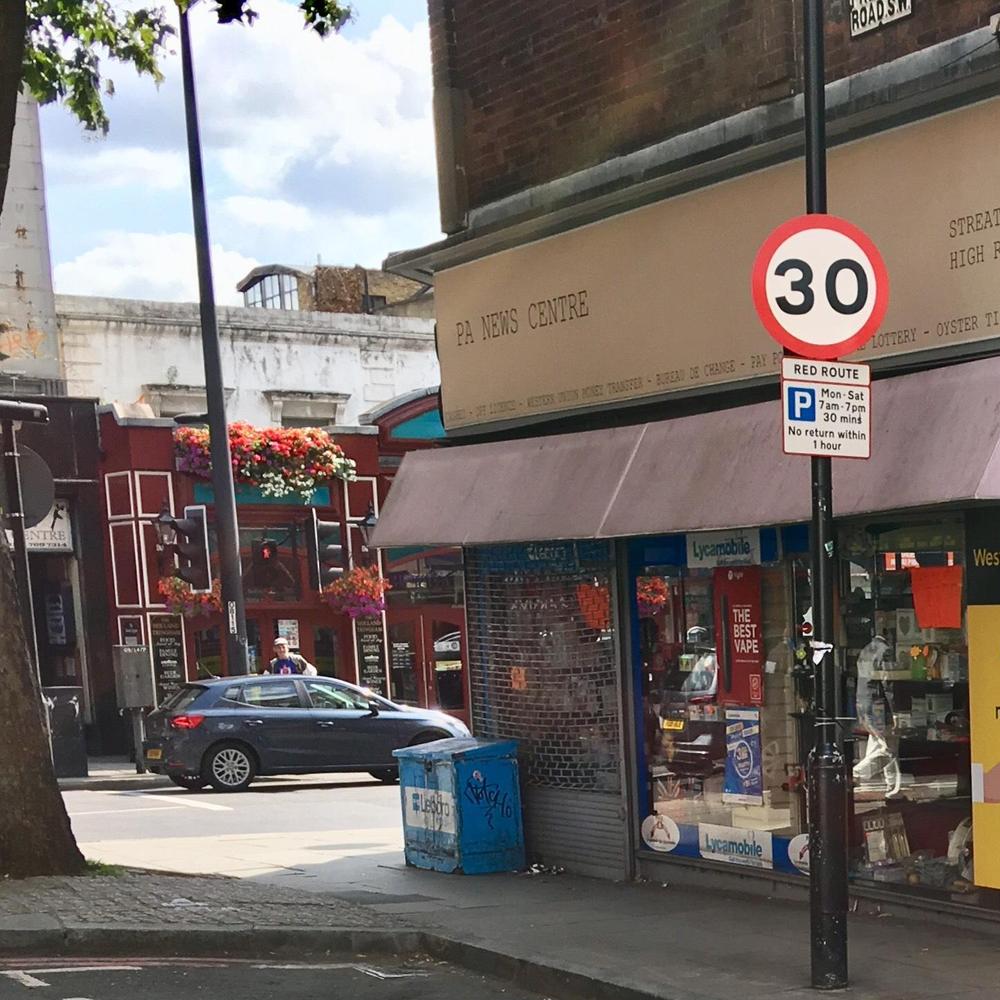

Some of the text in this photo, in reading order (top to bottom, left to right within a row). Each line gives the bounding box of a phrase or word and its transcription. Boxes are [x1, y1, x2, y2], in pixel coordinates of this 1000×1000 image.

[950, 245, 984, 270] HIGH
[774, 258, 869, 316] 30
[456, 290, 589, 346] PA NEWS CENTRE
[872, 327, 917, 346] LOTTERY
[936, 315, 979, 337] OYSTER
[794, 364, 859, 379] RED ROUTE
[823, 412, 862, 424] 30 mins
[788, 426, 866, 440] No return within
[820, 440, 842, 450] hour
[693, 538, 751, 561] Lycamobile
[732, 608, 751, 622] THE
[733, 624, 757, 638] BEST
[734, 639, 759, 653] VAPE
[705, 833, 763, 857] Lycamobile
